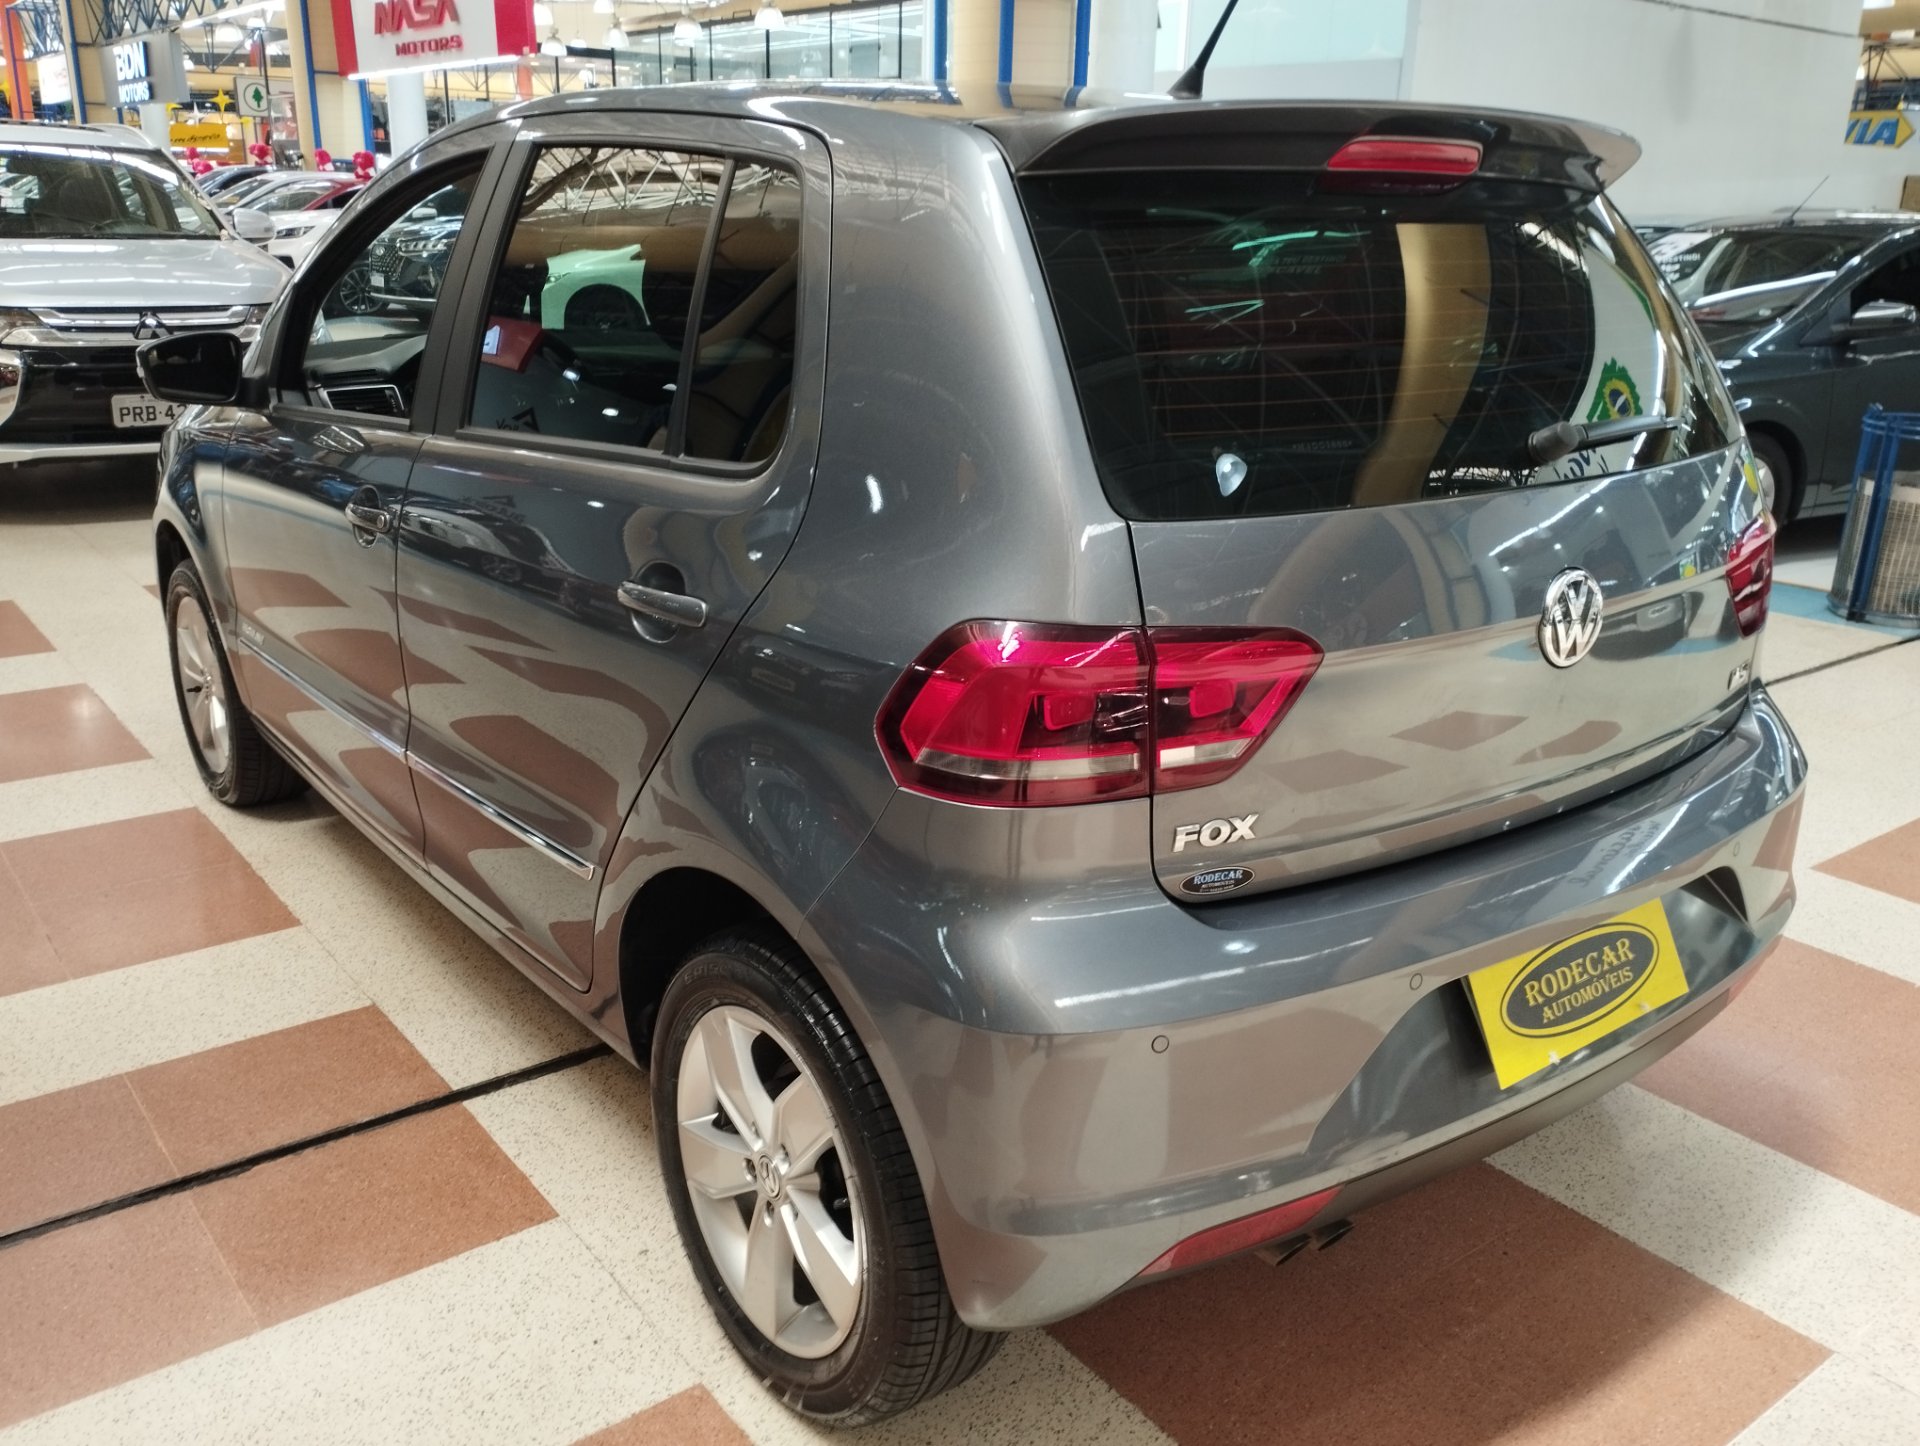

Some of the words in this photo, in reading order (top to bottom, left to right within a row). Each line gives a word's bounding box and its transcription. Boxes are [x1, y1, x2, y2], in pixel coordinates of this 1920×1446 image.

[374, 0, 460, 35] NASA
[113, 40, 149, 81] BDN
[395, 34, 463, 56] MOTORS
[118, 80, 151, 103] MOTORS
[1172, 813, 1259, 853] FOX
[1193, 869, 1244, 885] RODECAR
[1524, 937, 1636, 1008] RODECAR
[1542, 966, 1634, 1024] AUTOMÓVEIS
